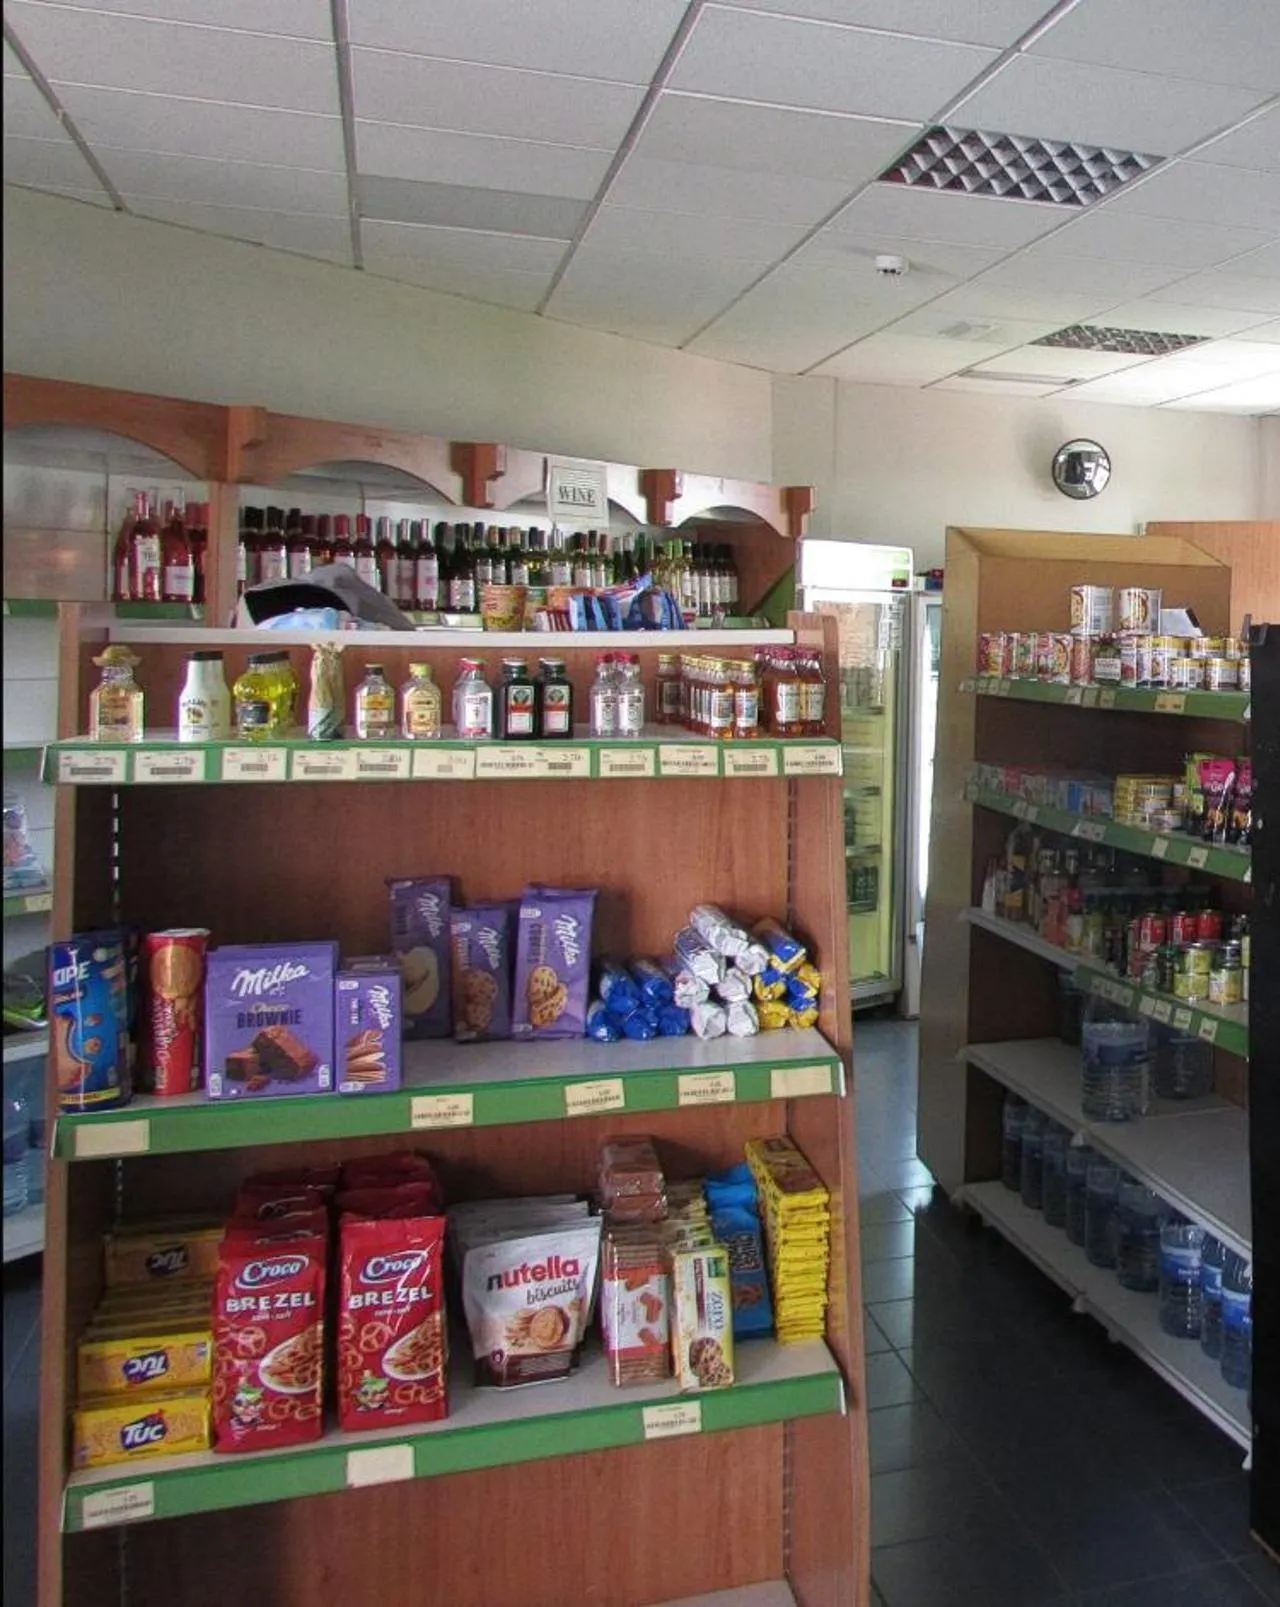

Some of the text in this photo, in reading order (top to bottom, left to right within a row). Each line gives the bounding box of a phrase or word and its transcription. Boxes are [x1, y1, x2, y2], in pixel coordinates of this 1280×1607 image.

[559, 485, 596, 504] WINE
[418, 892, 444, 938] Milka
[477, 926, 501, 970] Milka
[554, 913, 581, 967] Milka
[230, 961, 312, 997] Milka
[236, 1009, 302, 1029] BROWNIE
[367, 984, 394, 1030] Milka
[242, 1260, 302, 1283] Croco
[366, 1255, 422, 1279] Croco
[486, 1255, 580, 1293] nutella
[225, 1291, 316, 1314] BREZEL
[350, 1284, 434, 1310] BREZEL
[526, 1277, 581, 1306] biscuits
